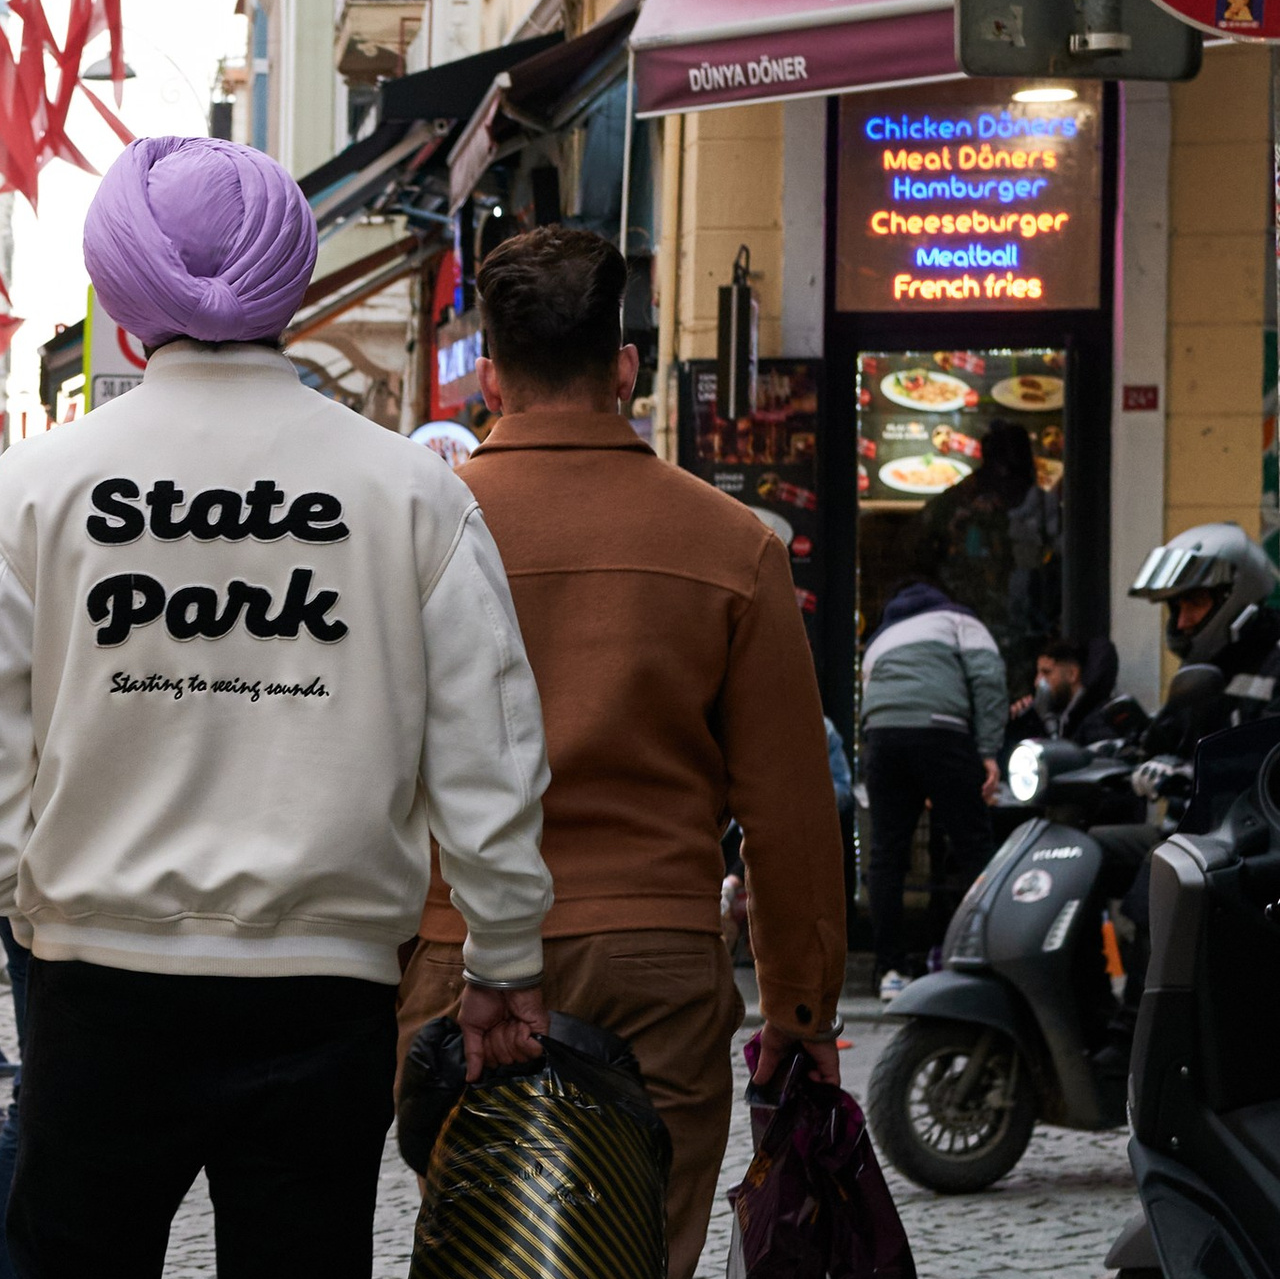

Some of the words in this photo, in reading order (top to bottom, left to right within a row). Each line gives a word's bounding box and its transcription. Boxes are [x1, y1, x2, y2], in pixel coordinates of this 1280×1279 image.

[688, 61, 746, 92] DÜNYA
[747, 54, 808, 85] DÖNER
[865, 114, 973, 140] Chicken
[977, 110, 1079, 139] Döners
[883, 146, 953, 171] Meat
[957, 142, 1058, 171] Döners
[892, 174, 1049, 203] Hamburger
[870, 210, 1070, 239] Cheeseburger
[916, 243, 1018, 268] Meatball
[893, 273, 981, 300] French
[983, 271, 1043, 299] fries
[86, 477, 350, 544] State
[86, 567, 349, 646] Park
[110, 672, 184, 700] Starting
[187, 674, 208, 693] to
[210, 677, 262, 703] seeing
[264, 676, 330, 698] sounds.
